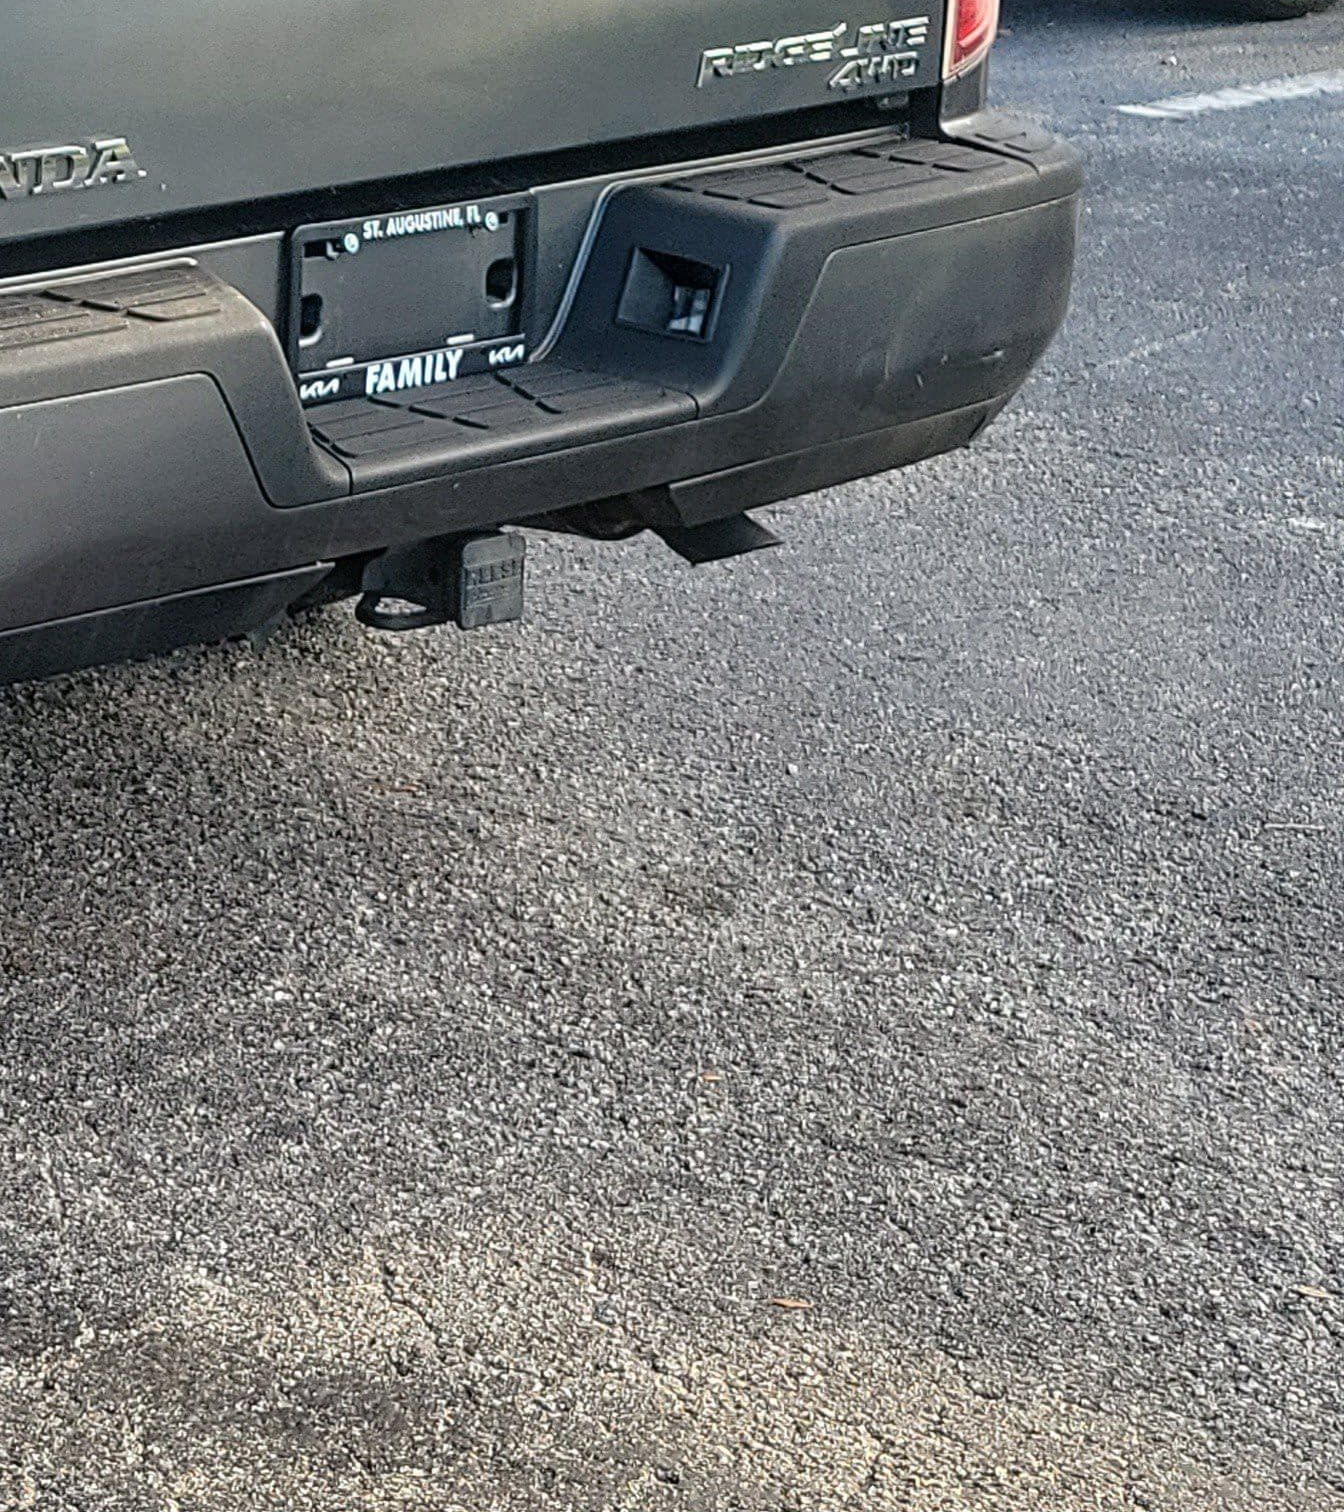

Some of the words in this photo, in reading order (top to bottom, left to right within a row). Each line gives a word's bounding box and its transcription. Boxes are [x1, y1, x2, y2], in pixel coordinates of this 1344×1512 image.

[695, 16, 930, 88] RIDGELINE
[362, 220, 383, 240] ST.
[386, 208, 464, 237] AUGUSTINE,
[466, 205, 481, 224] FL
[364, 349, 464, 395] FAMILY
